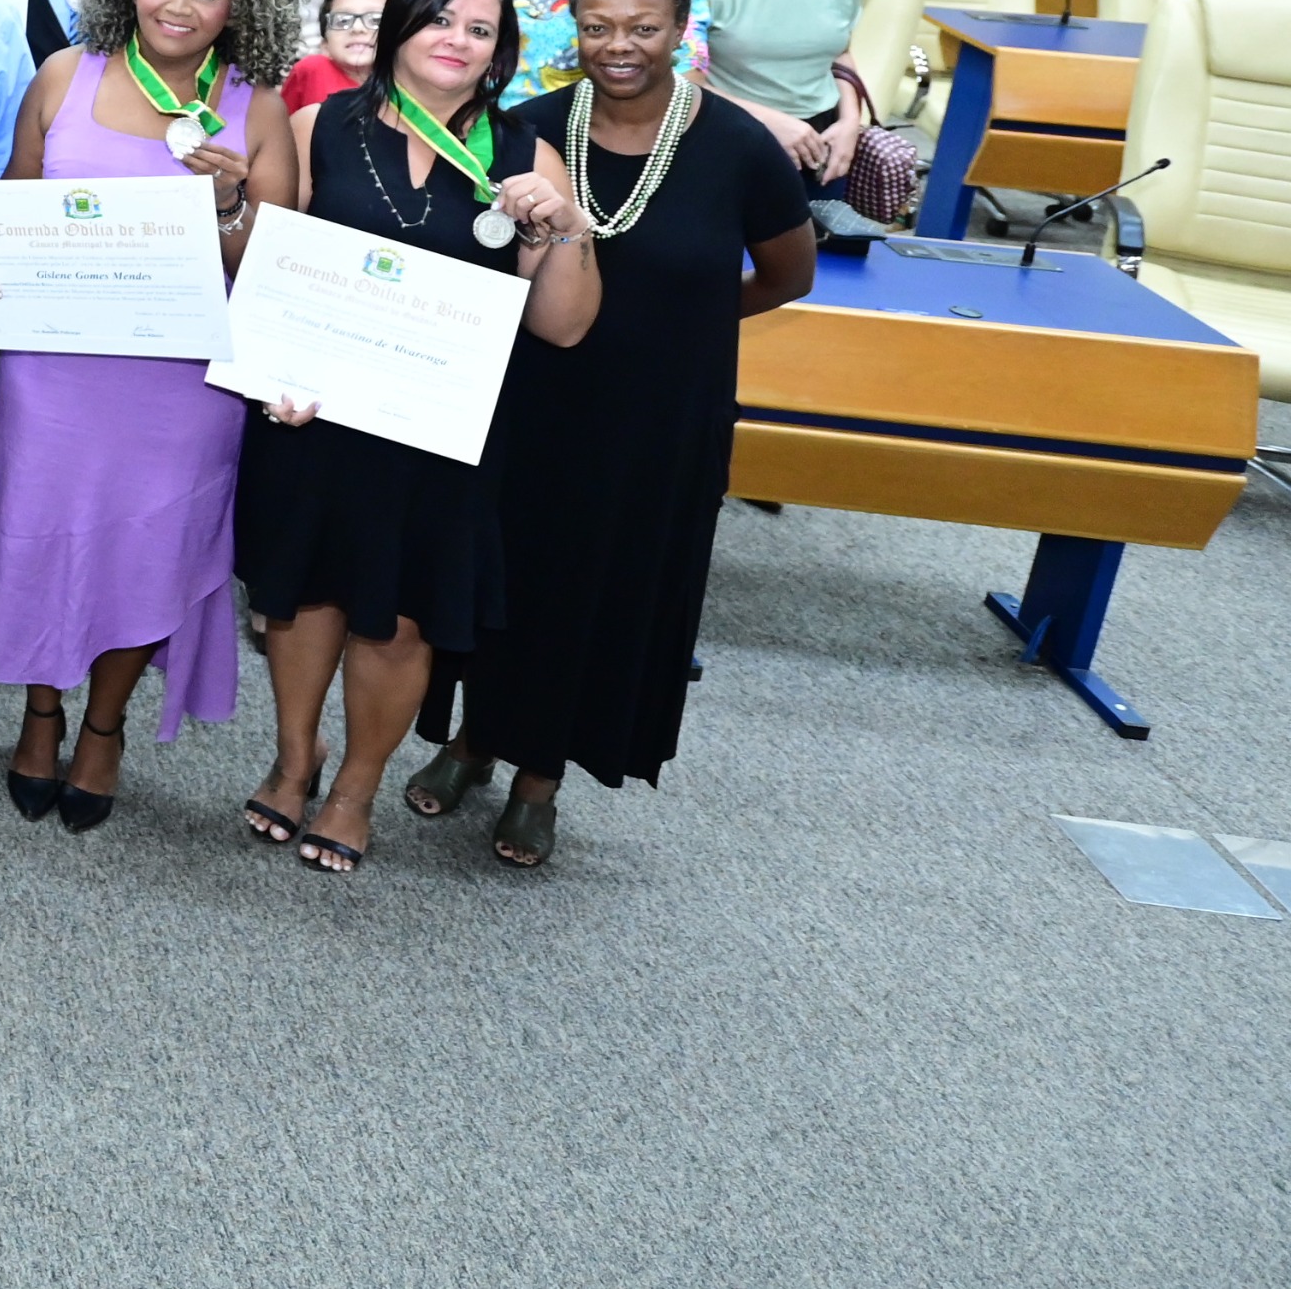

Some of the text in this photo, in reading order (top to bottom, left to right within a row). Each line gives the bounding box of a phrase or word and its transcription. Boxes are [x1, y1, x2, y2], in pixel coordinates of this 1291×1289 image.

[119, 223, 135, 237] de
[141, 221, 186, 238] Brito
[37, 270, 152, 281] Gislene Gomes Mendes
